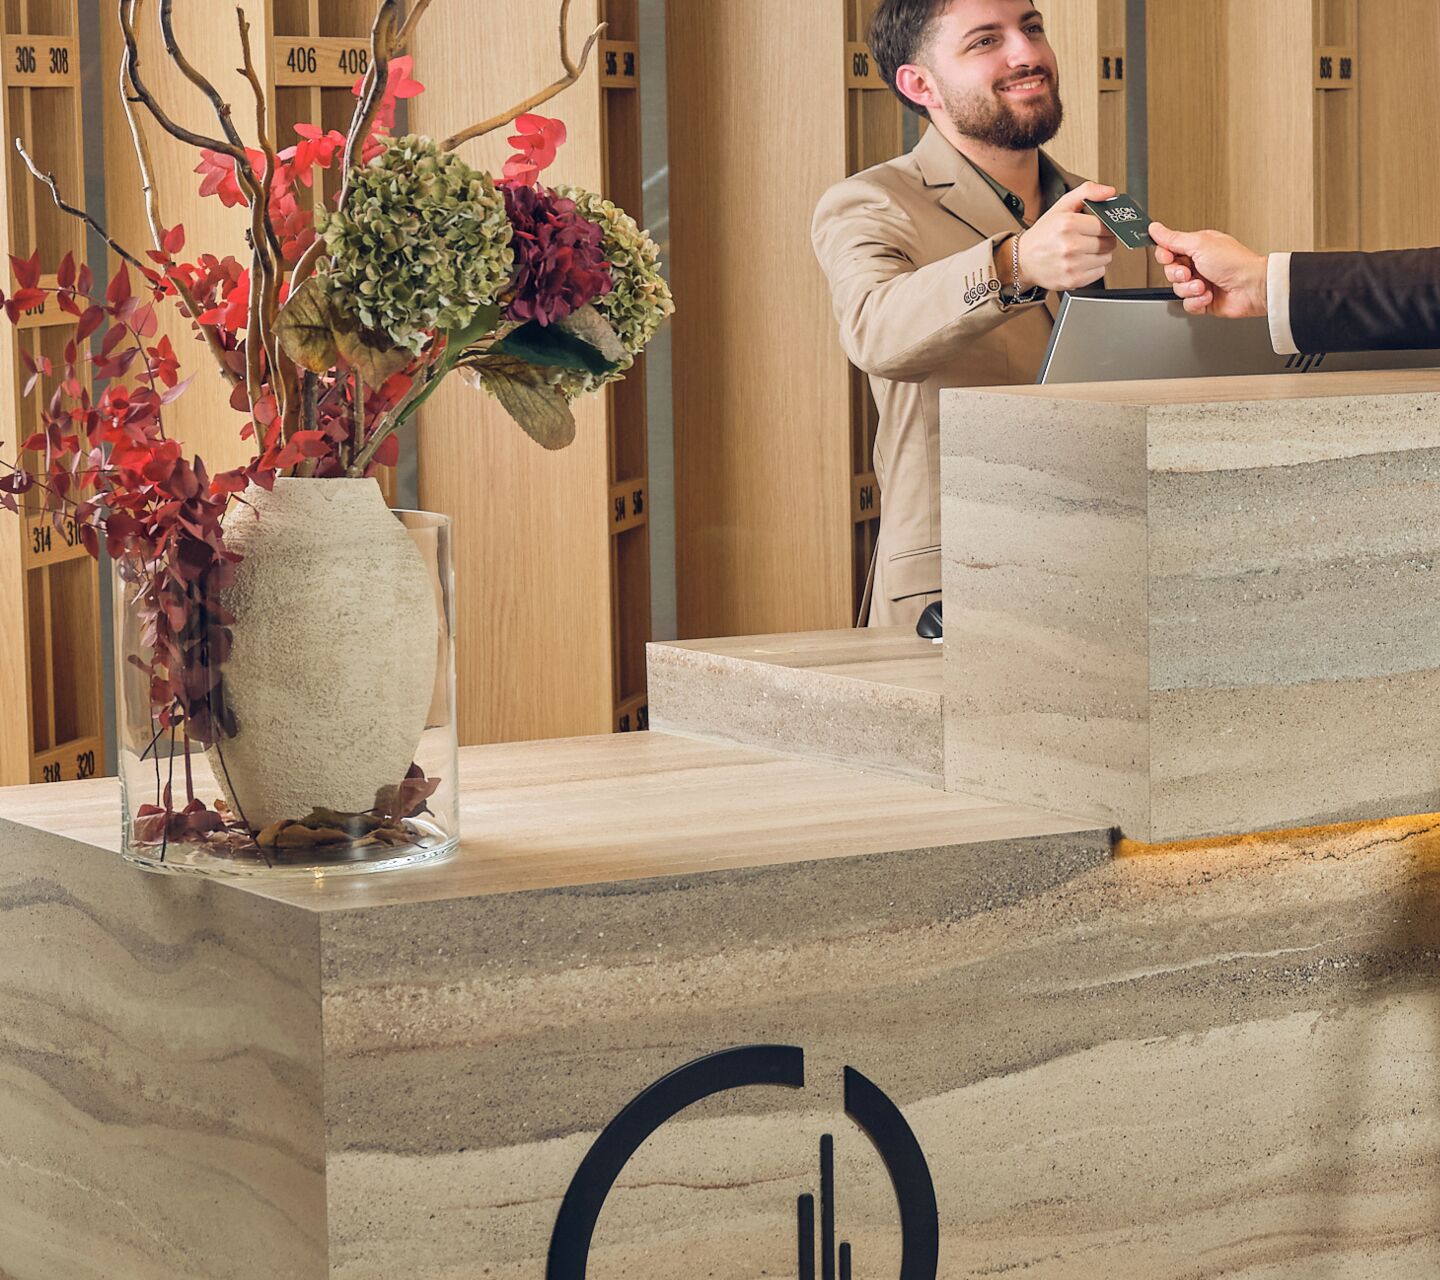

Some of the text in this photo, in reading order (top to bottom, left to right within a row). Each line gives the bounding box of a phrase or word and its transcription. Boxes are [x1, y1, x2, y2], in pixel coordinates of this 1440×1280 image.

[16, 46, 69, 74] 306 308
[287, 46, 368, 75] 406 408
[853, 52, 868, 77] 606
[33, 521, 83, 554] 314 31
[76, 750, 95, 780] 320
